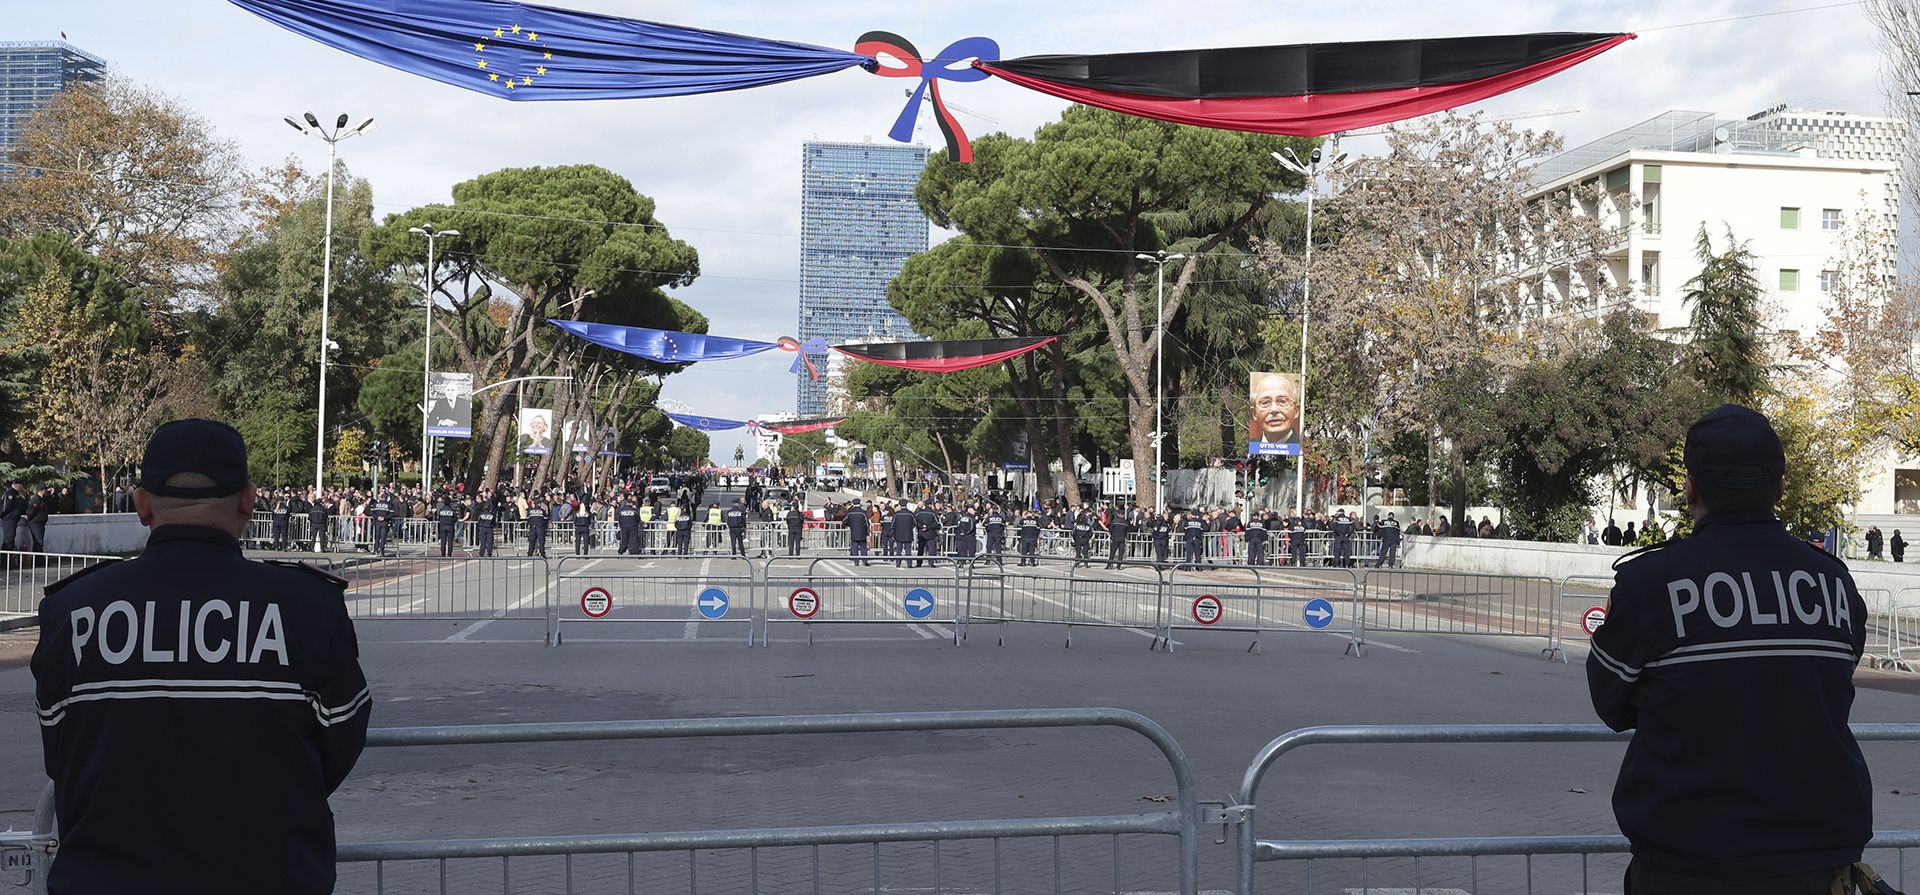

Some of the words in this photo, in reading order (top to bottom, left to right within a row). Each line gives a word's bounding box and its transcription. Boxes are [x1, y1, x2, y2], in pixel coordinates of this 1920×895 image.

[1769, 103, 1787, 115] PLAZA
[70, 599, 290, 667] POLICIA
[1667, 569, 1853, 639] POLICIA
